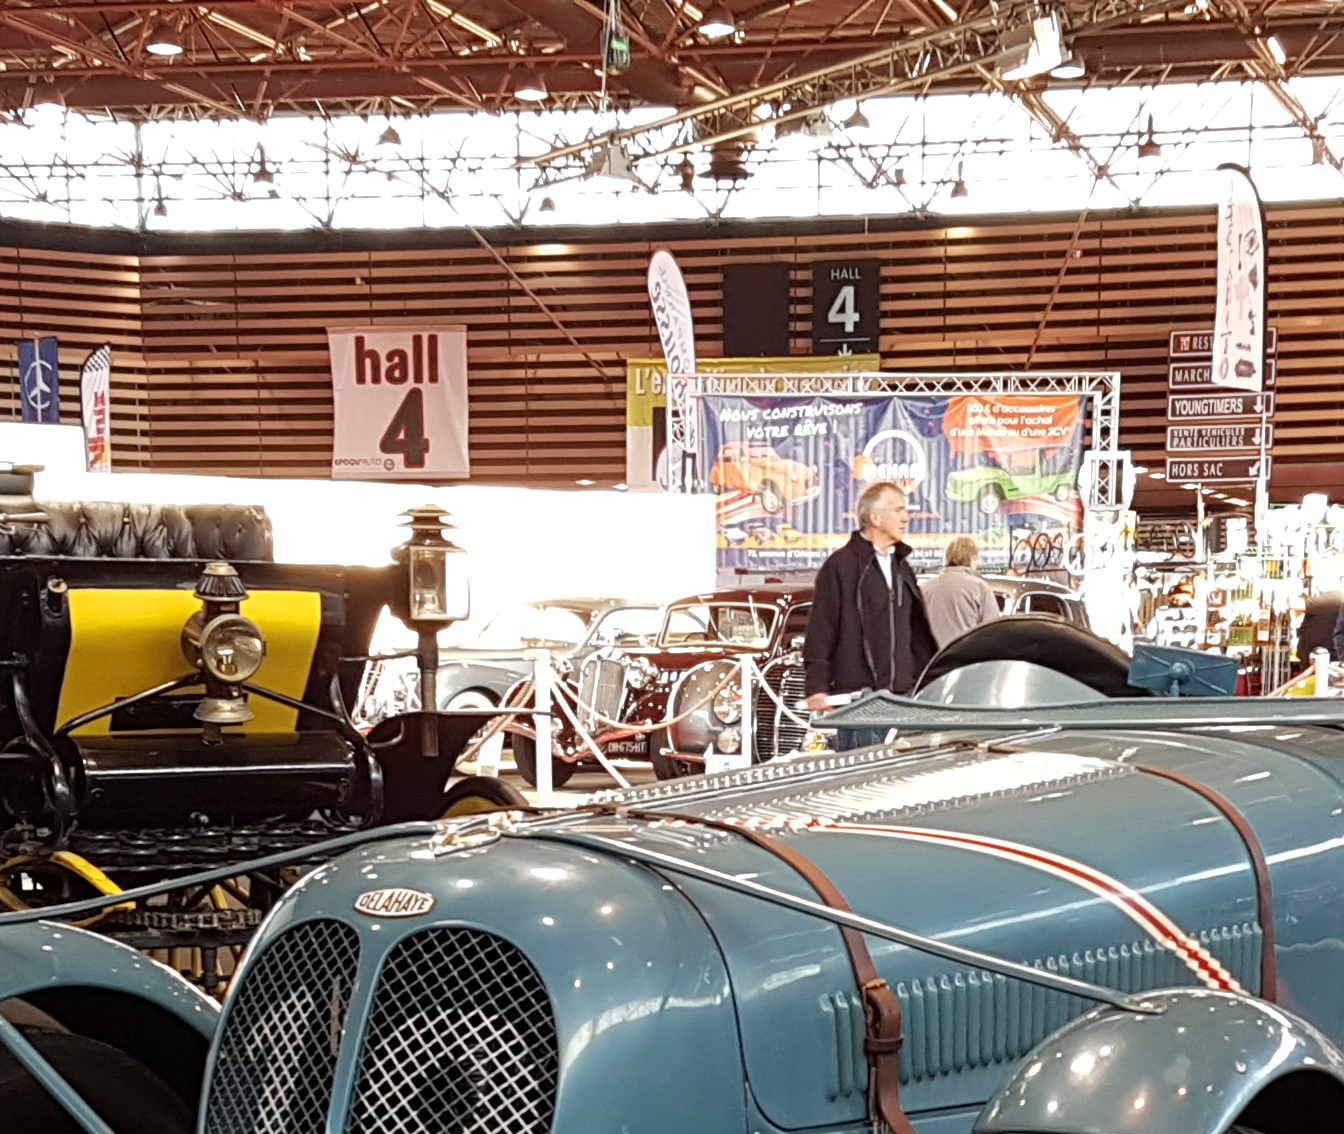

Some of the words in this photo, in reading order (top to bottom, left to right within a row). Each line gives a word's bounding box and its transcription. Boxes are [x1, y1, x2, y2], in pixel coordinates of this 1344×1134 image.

[831, 267, 861, 280] HALL
[827, 286, 860, 333] 4
[355, 334, 438, 385] hall
[1174, 398, 1244, 415] YOUNGTIMERS
[379, 387, 430, 469] 4
[997, 417, 1018, 425] pour
[1172, 436, 1244, 448] PARTICULIERS
[1171, 463, 1199, 477] HORS
[1203, 462, 1223, 476] SAC
[359, 890, 429, 912] DELAHAYE
